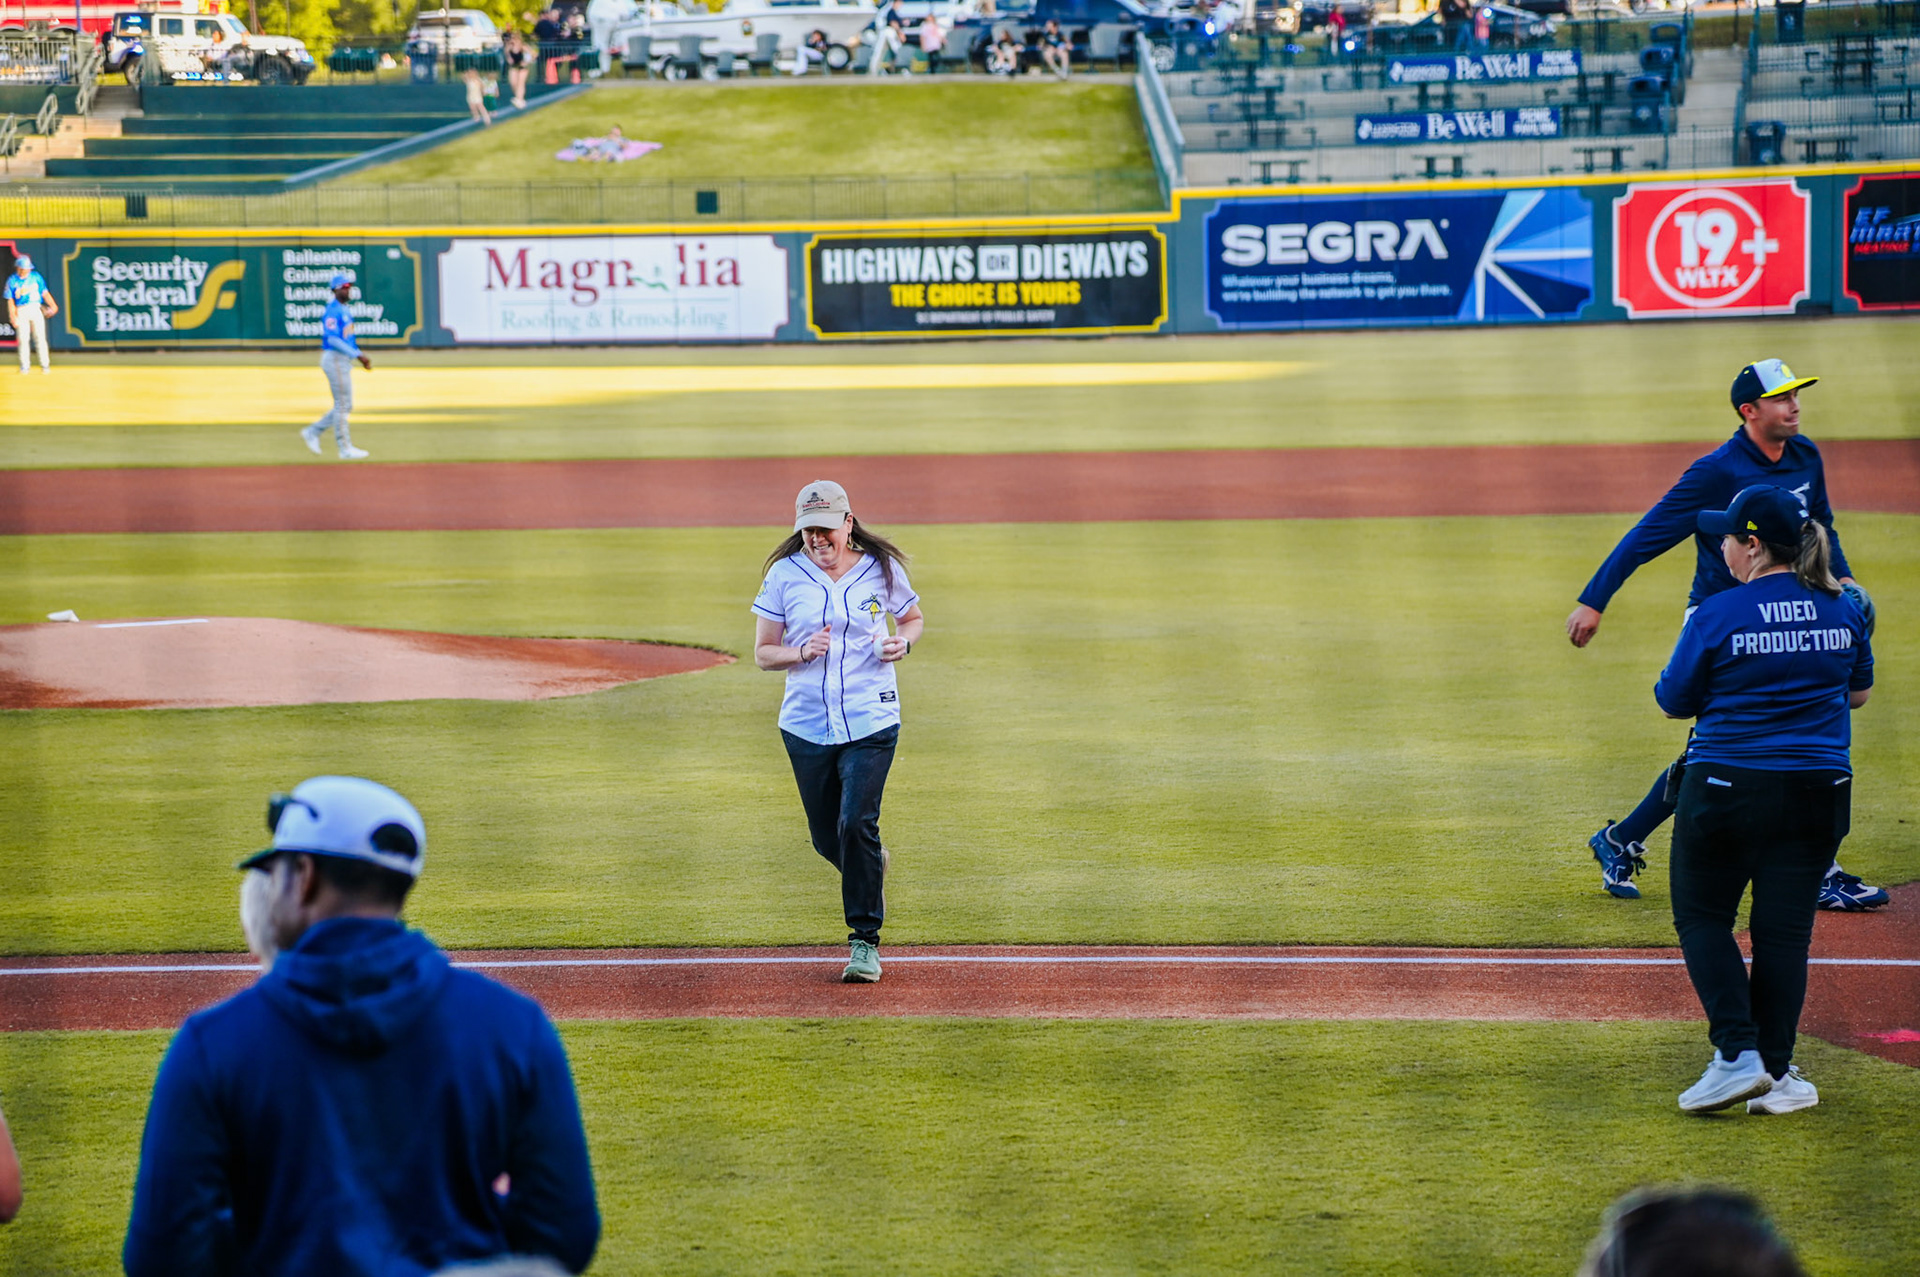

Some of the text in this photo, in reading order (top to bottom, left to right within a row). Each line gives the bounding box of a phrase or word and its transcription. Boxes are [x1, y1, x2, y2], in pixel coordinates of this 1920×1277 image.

[1455, 55, 1484, 80] Be
[1482, 52, 1530, 79] Well
[1426, 112, 1456, 140] Be
[1454, 110, 1506, 138] Well
[1221, 218, 1449, 267] SEGRA
[92, 254, 208, 288] Security
[283, 249, 361, 266] Ballentine
[821, 245, 975, 284] HIGHWAYS
[1022, 240, 1148, 280] DIEWAYS
[484, 243, 742, 307] Magnlia
[1675, 265, 1739, 289] WLTX
[94, 281, 197, 307] Federal
[284, 284, 361, 304] Lexingn
[890, 281, 1081, 308] THE CHOICE IS YOURS
[96, 306, 172, 332] Bank
[285, 302, 326, 320] Sprin
[501, 307, 727, 334] Roofing & Remodeling
[1757, 600, 1818, 623] VIDEO
[1731, 628, 1852, 655] PRODUCTION
